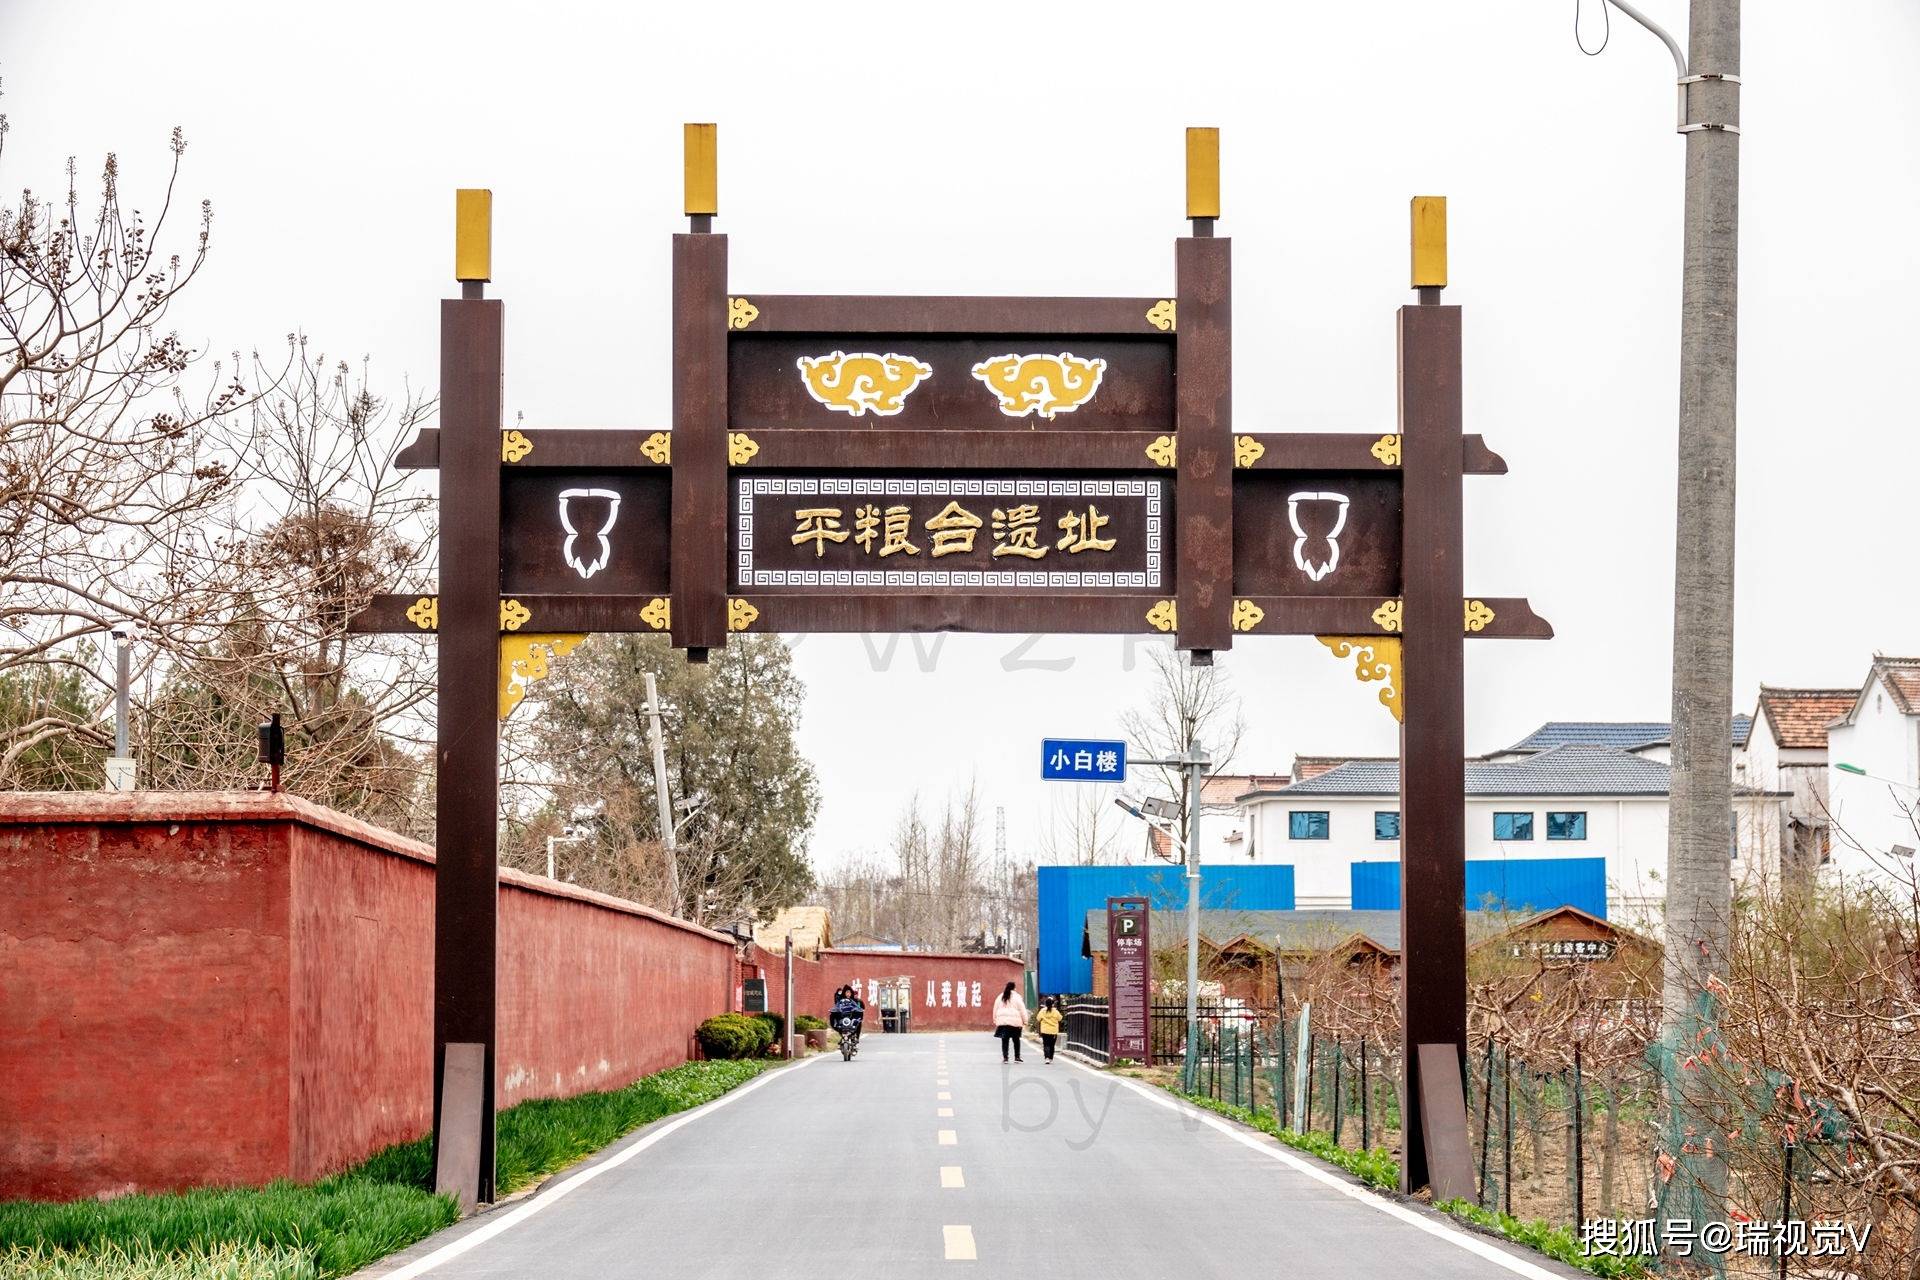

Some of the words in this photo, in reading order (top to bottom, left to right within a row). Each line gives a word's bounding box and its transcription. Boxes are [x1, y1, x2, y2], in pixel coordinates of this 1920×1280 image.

[1050, 749, 1118, 772] 小白楼
[1123, 919, 1134, 933] P
[1116, 938, 1142, 947] 停车场
[925, 980, 982, 1008] 从我做起
